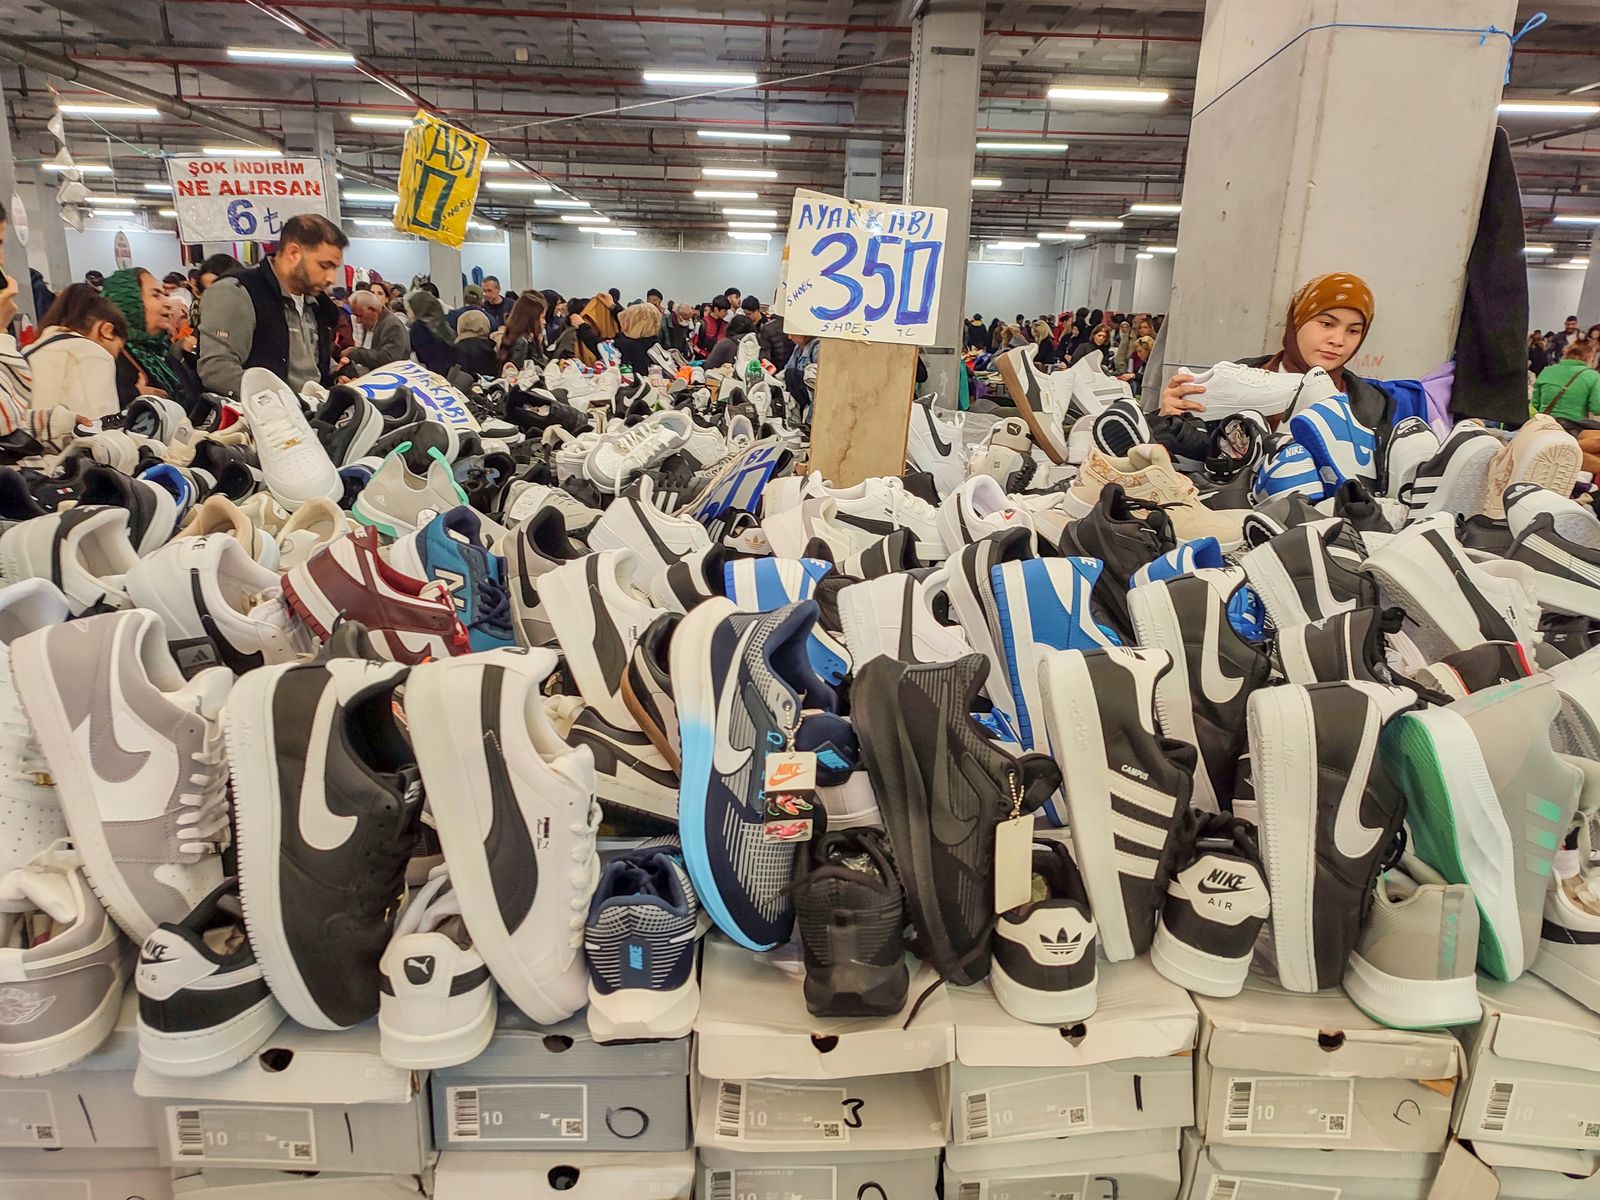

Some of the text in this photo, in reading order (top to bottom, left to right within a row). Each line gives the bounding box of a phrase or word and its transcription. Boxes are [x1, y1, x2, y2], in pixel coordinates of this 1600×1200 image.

[188, 159, 305, 177] ŞOK İNDİRİM
[177, 180, 321, 196] NE ALIRSAN
[227, 199, 258, 235] 6
[809, 232, 943, 325] 350
[786, 278, 814, 306] SHOES
[820, 321, 873, 336] SHOES
[1285, 446, 1305, 458] NIKE
[775, 763, 805, 776] NIKE
[1120, 764, 1149, 781] CAMPUS
[1207, 868, 1247, 890] NIKE
[1207, 897, 1233, 911] AIR
[481, 1110, 503, 1126] 10
[747, 1109, 768, 1126] 10
[841, 1097, 865, 1129] 3
[993, 1109, 1014, 1126] 10
[1256, 1104, 1275, 1120] 10
[205, 1130, 229, 1147] 10
